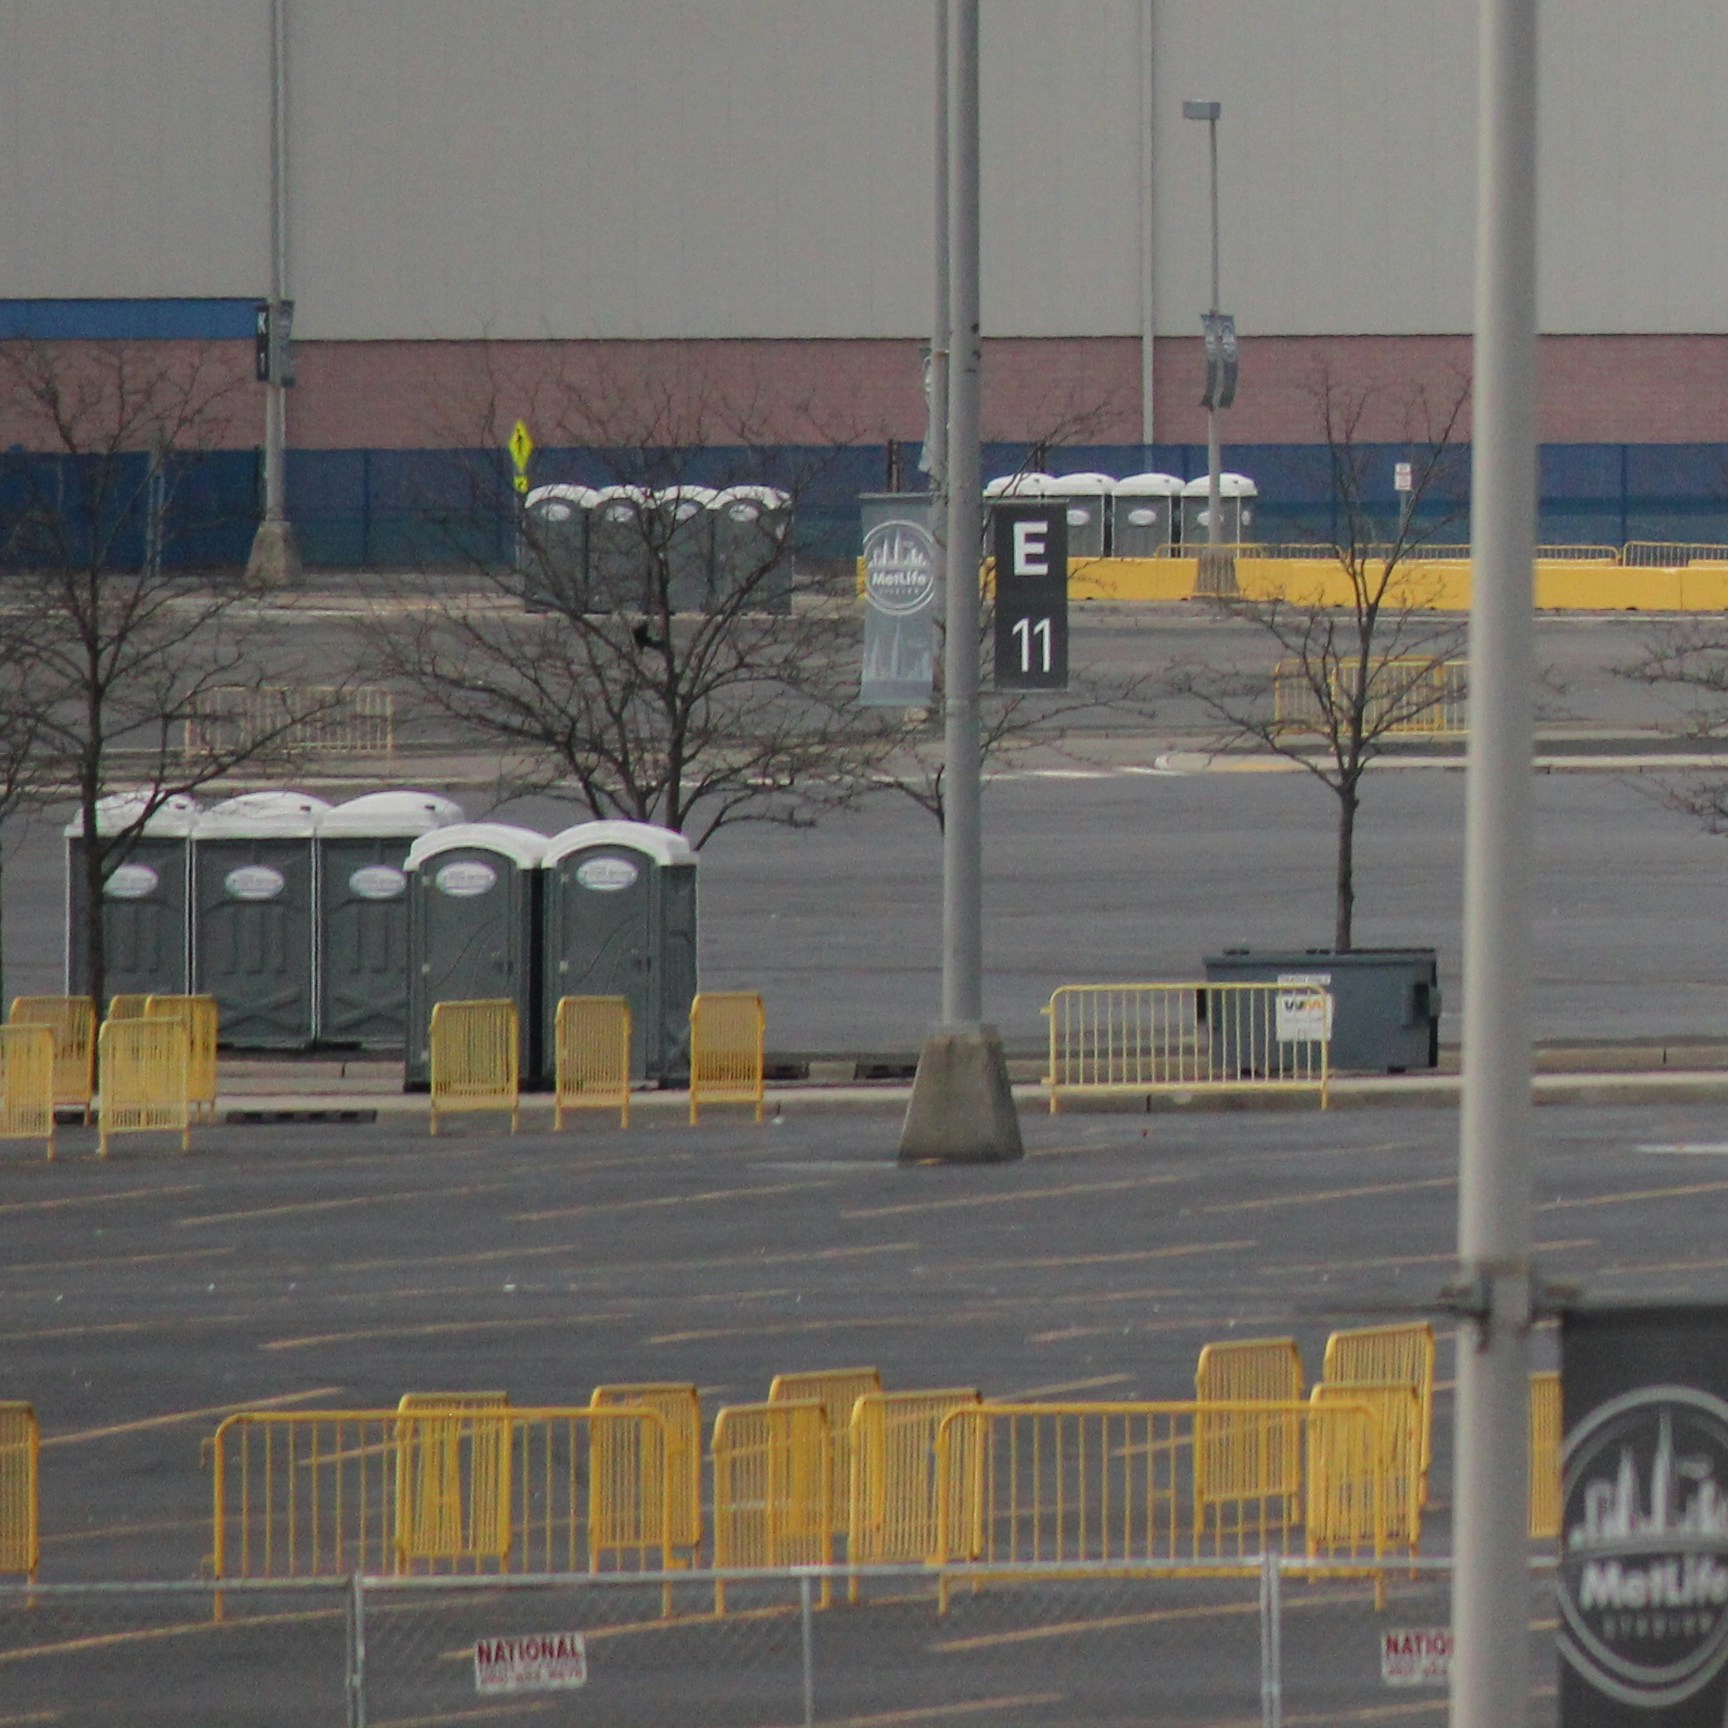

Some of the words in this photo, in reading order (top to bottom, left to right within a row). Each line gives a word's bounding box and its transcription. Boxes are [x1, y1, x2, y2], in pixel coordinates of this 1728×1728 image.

[1013, 521, 1049, 576] E
[871, 569, 927, 587] MetLife
[1012, 617, 1051, 673] 11
[477, 1633, 582, 1664] NATIONAL
